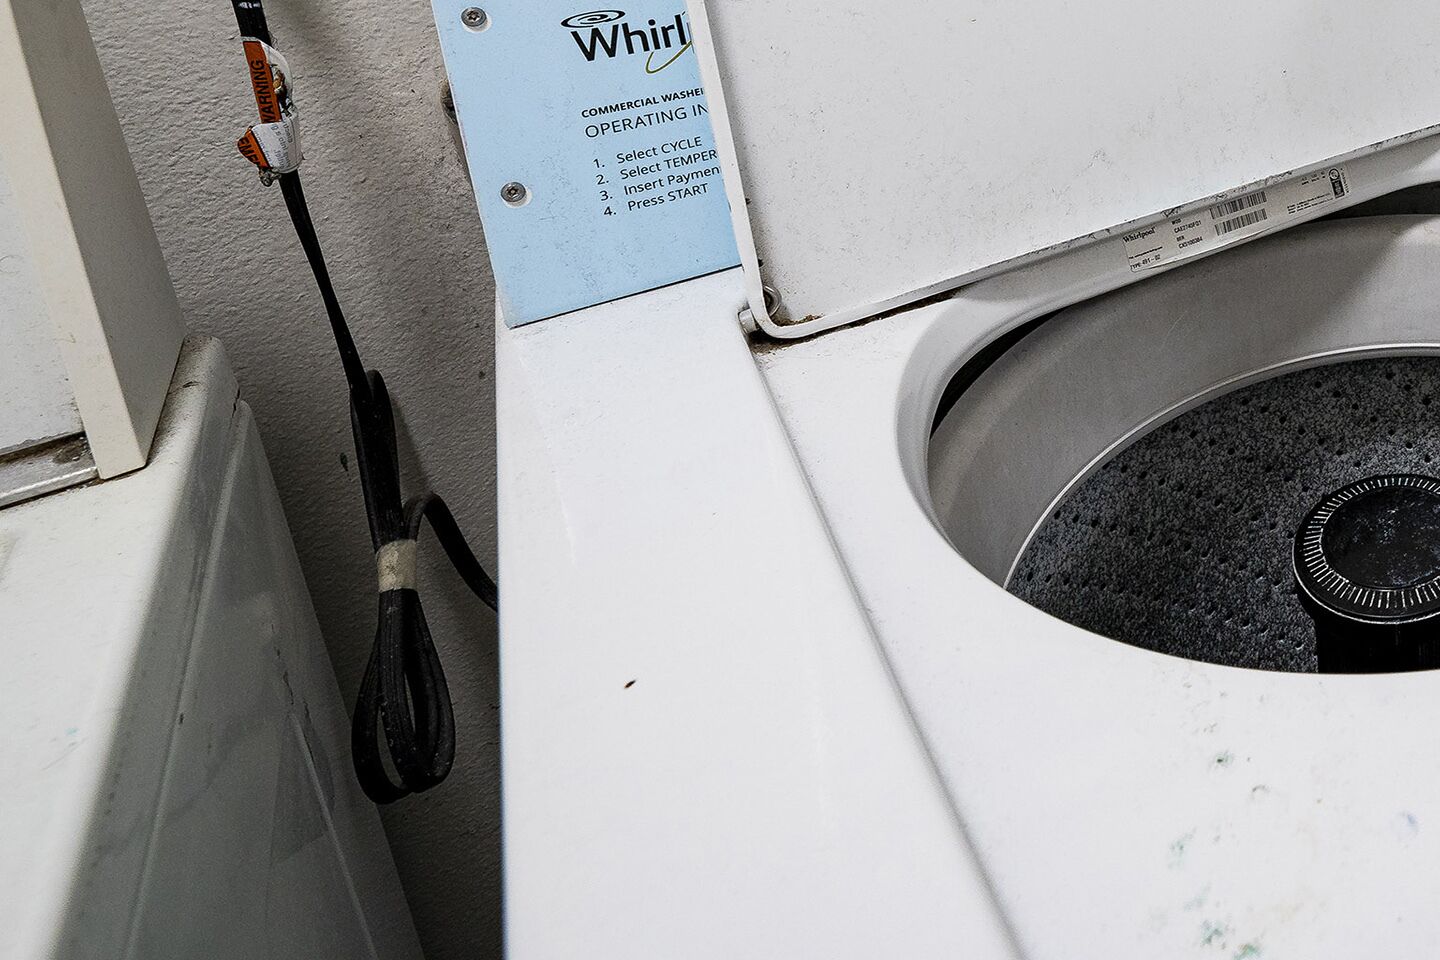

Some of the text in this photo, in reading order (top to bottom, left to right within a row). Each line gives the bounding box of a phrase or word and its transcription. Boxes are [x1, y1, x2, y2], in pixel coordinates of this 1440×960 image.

[570, 12, 691, 62] Whirl
[581, 96, 659, 118] COMMERCIAL
[585, 107, 687, 138] OPERATING
[594, 136, 702, 169] 1. Select CYCLE
[596, 175, 609, 185] 2.
[620, 163, 662, 180] Select
[600, 167, 720, 201] 3. Insert Paymen
[604, 183, 708, 217] 4. Press START
[1123, 227, 1155, 242] Whirlpool
